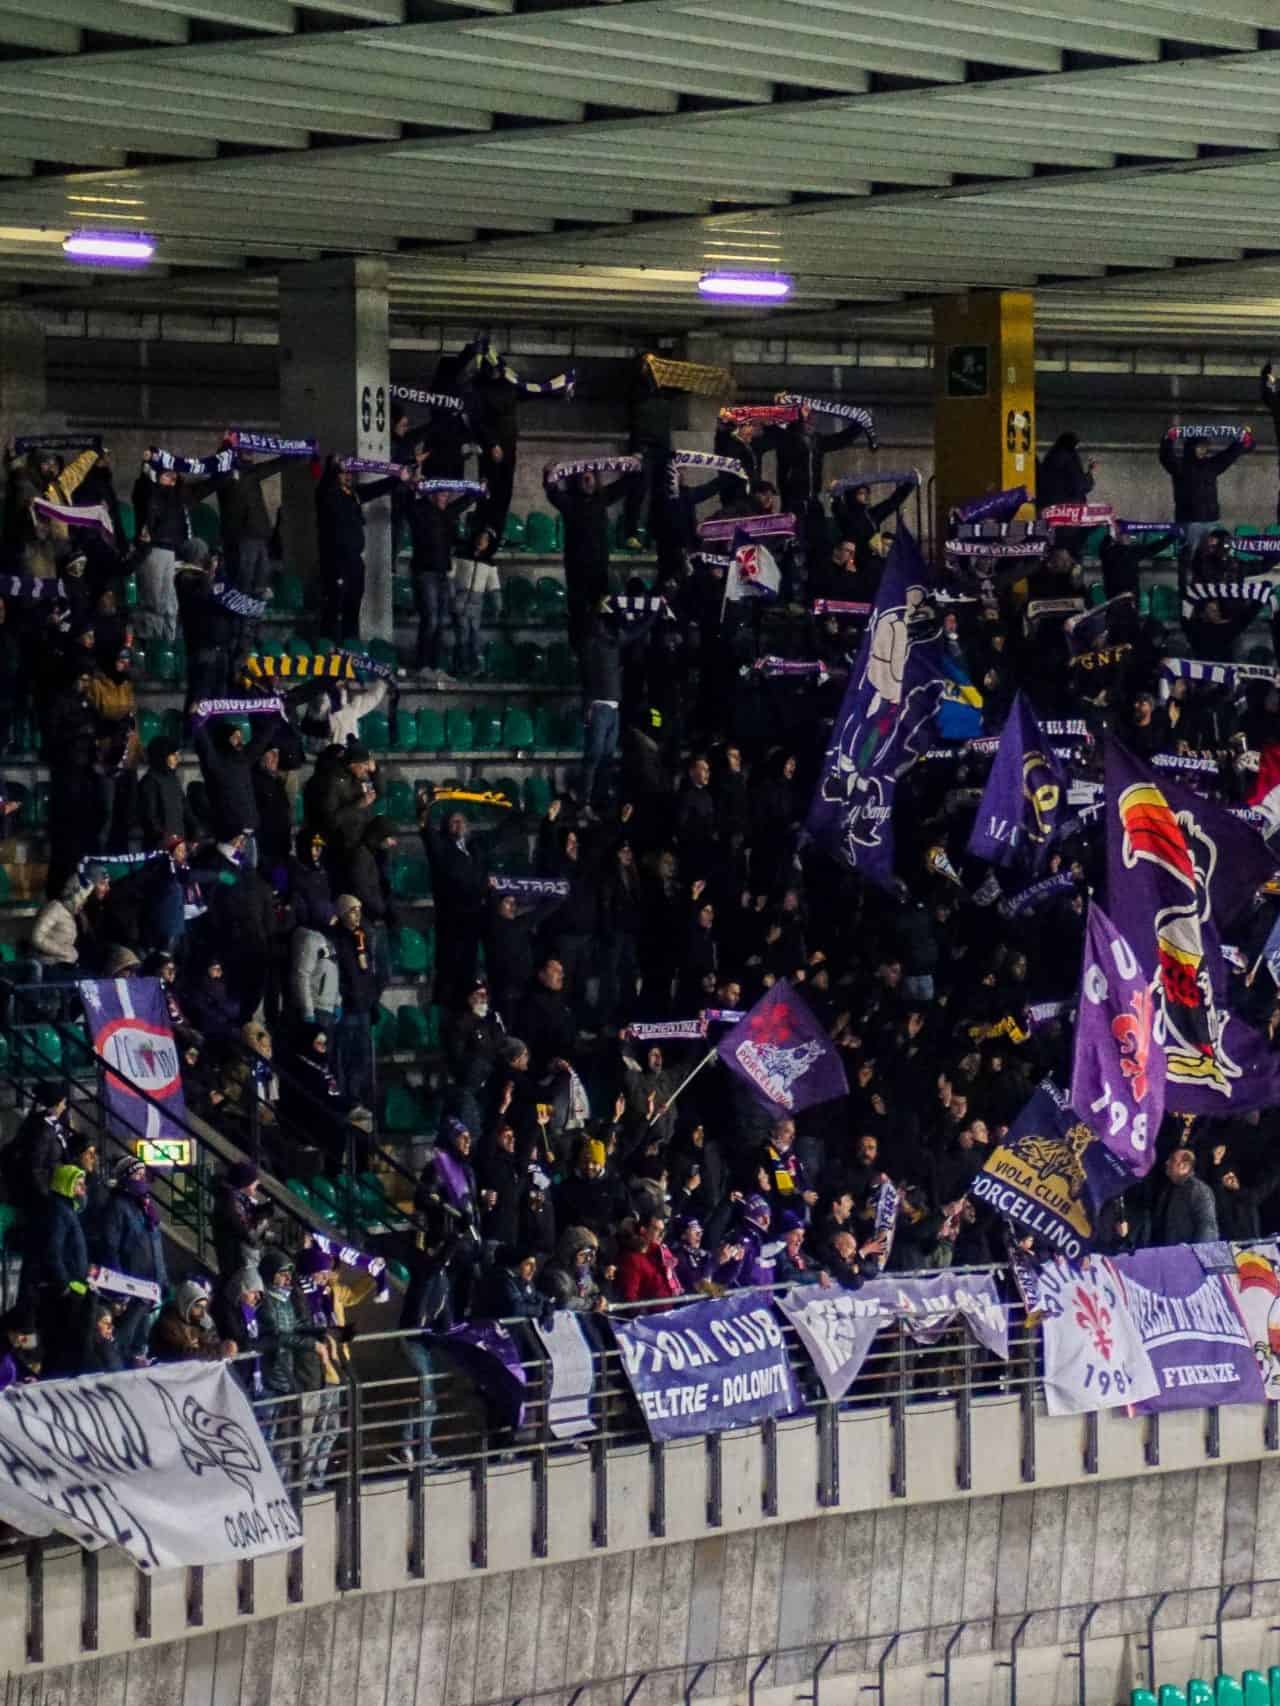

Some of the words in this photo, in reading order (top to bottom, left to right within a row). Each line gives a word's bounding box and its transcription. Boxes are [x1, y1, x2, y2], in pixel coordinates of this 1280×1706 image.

[361, 386, 386, 433] 68
[994, 1160, 1034, 1188] VIOLA
[1035, 1183, 1074, 1217] CLUB
[616, 1325, 720, 1377] VIOLA
[709, 1308, 782, 1361] CLUB
[1161, 1362, 1241, 1390] FIRENZE
[223, 1509, 270, 1549] CURVA
